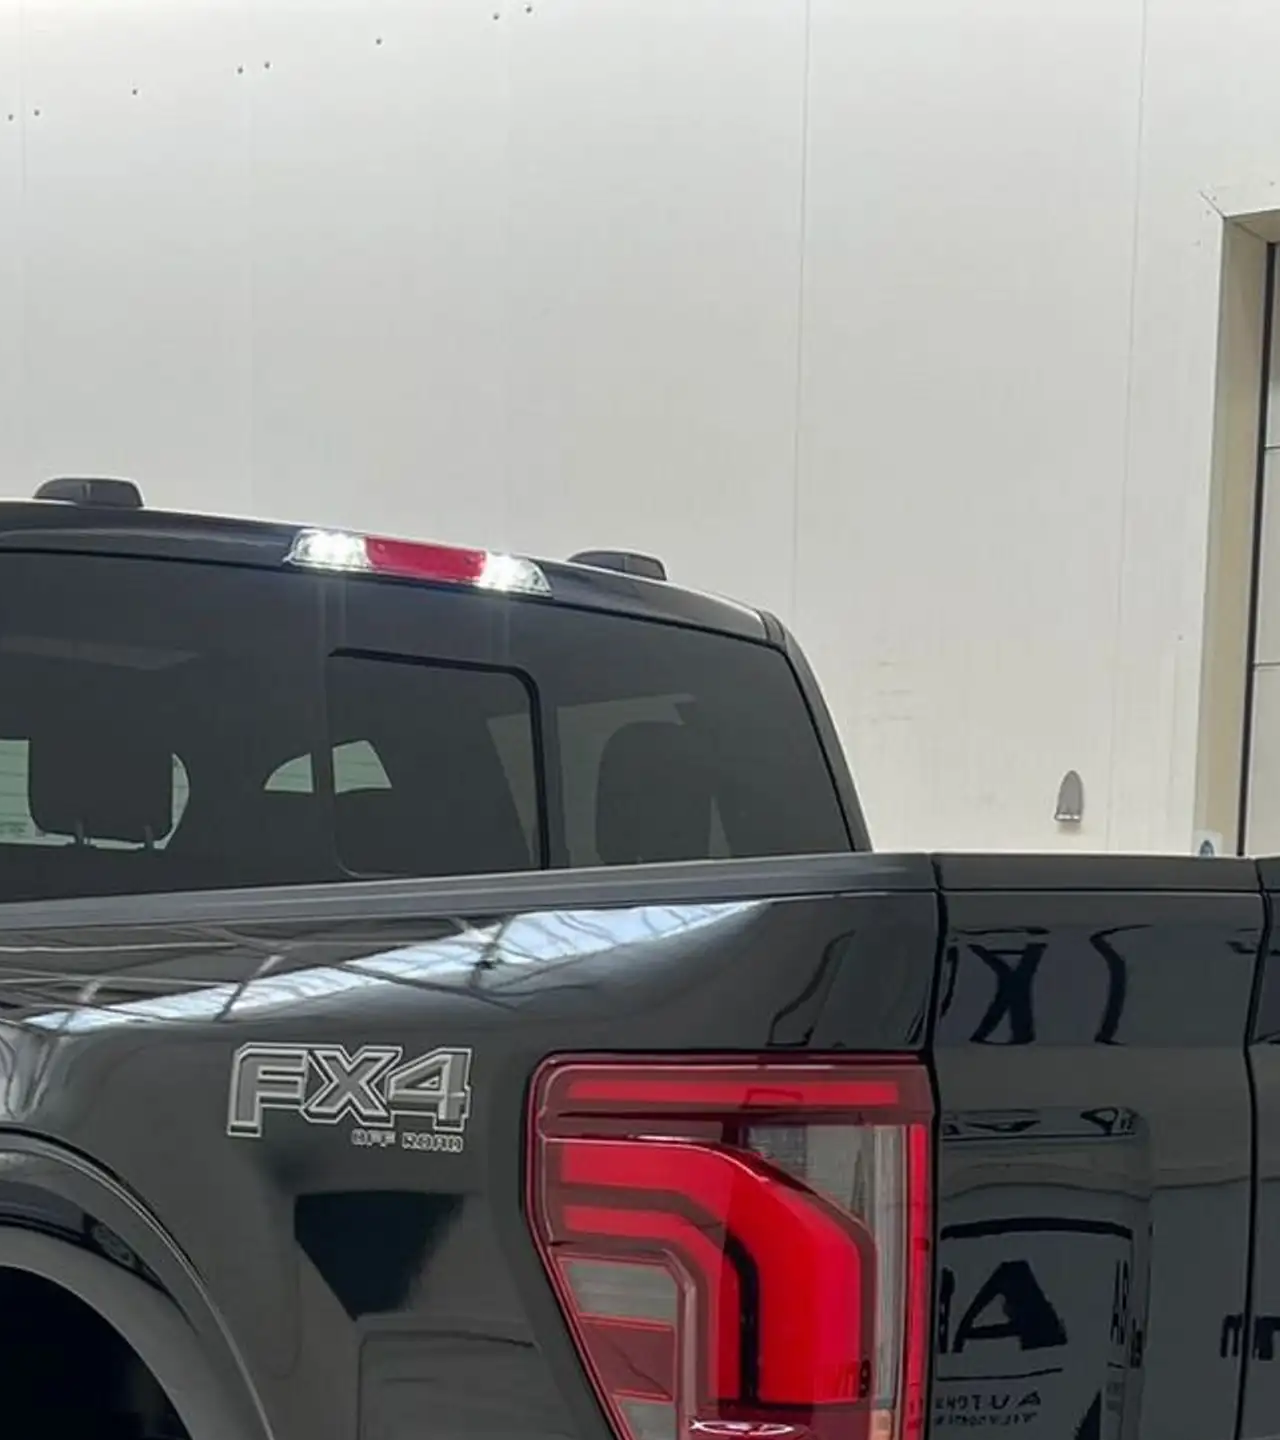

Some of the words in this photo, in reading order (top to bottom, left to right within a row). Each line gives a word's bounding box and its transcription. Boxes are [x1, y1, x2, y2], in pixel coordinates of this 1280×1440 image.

[228, 1042, 472, 1137] FX4
[351, 1128, 396, 1149] OFF
[402, 1131, 464, 1153] ROAD
